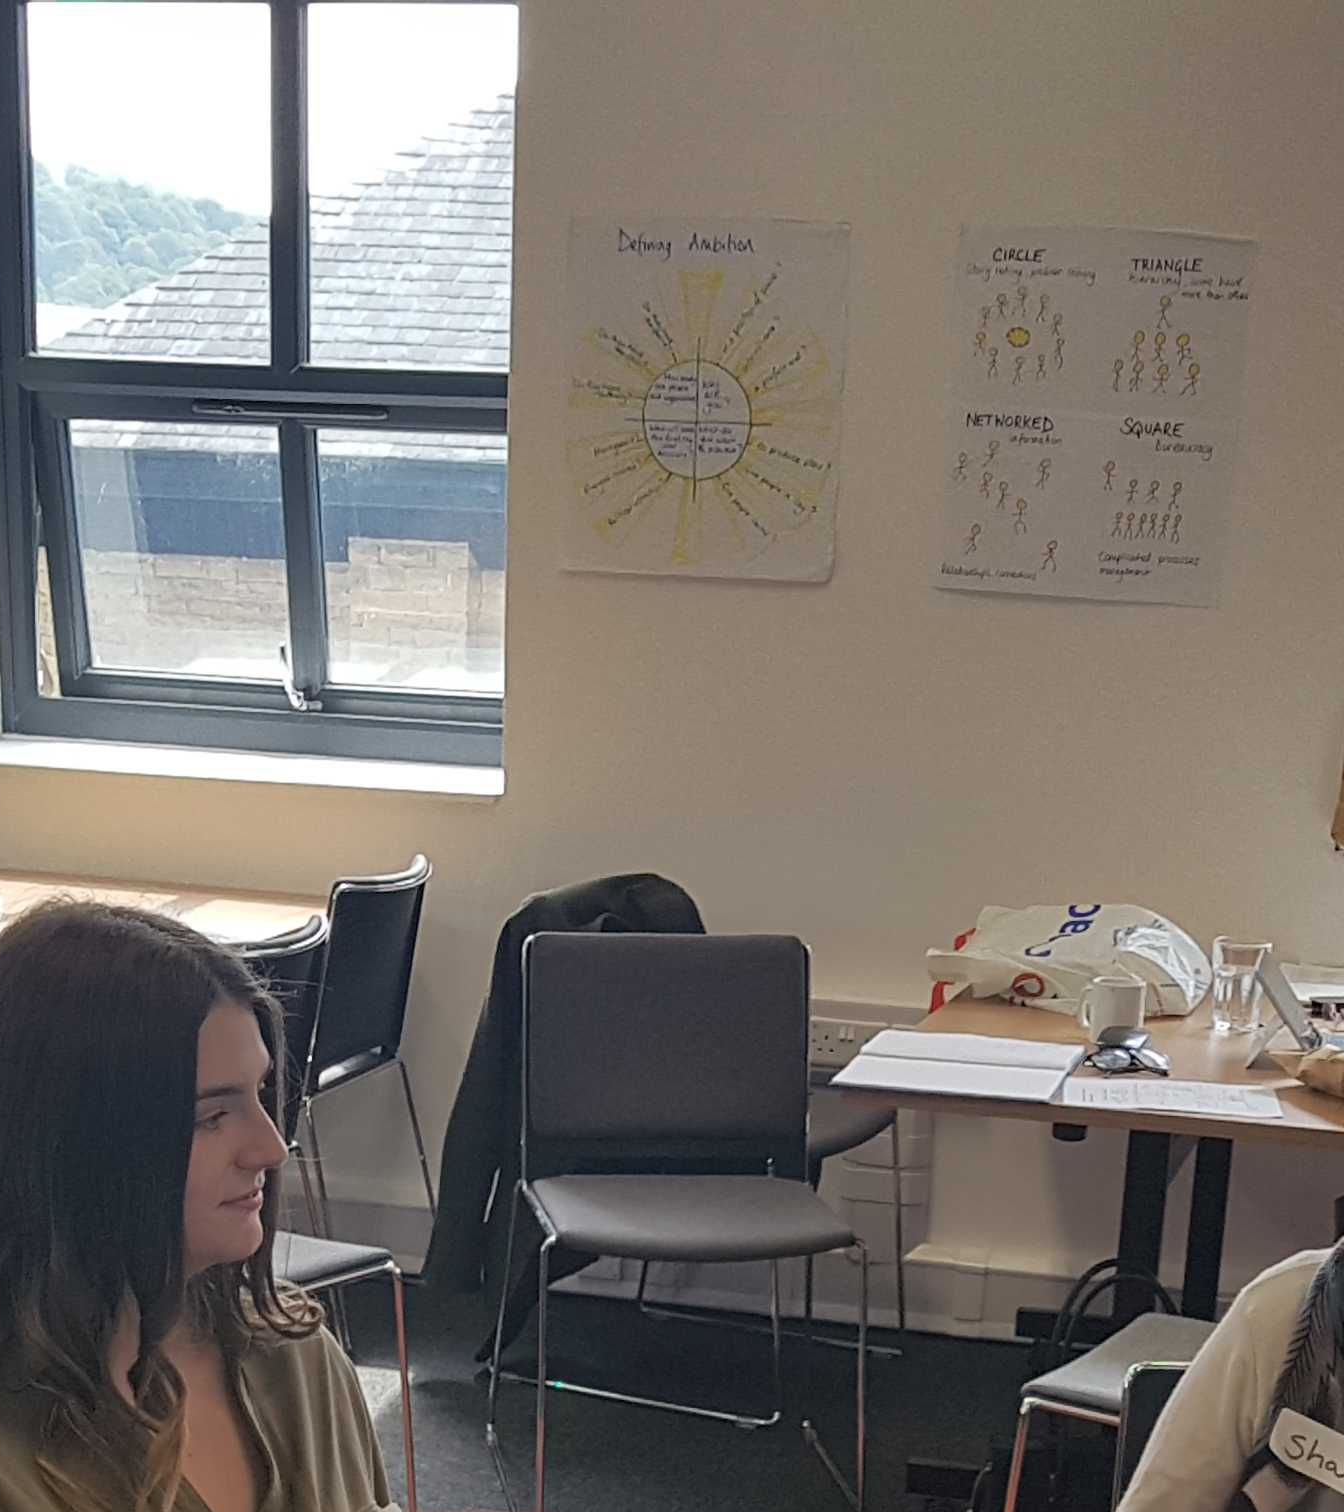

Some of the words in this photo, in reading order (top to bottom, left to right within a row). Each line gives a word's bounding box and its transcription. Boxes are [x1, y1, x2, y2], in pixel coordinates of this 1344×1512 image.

[618, 228, 672, 262] Defining
[688, 232, 755, 253] Ambition
[992, 248, 1046, 263] CIRCLE
[1131, 258, 1203, 273] TRIANGLE
[966, 412, 1054, 434] NETWORKED
[1120, 417, 1185, 438] SQUARE
